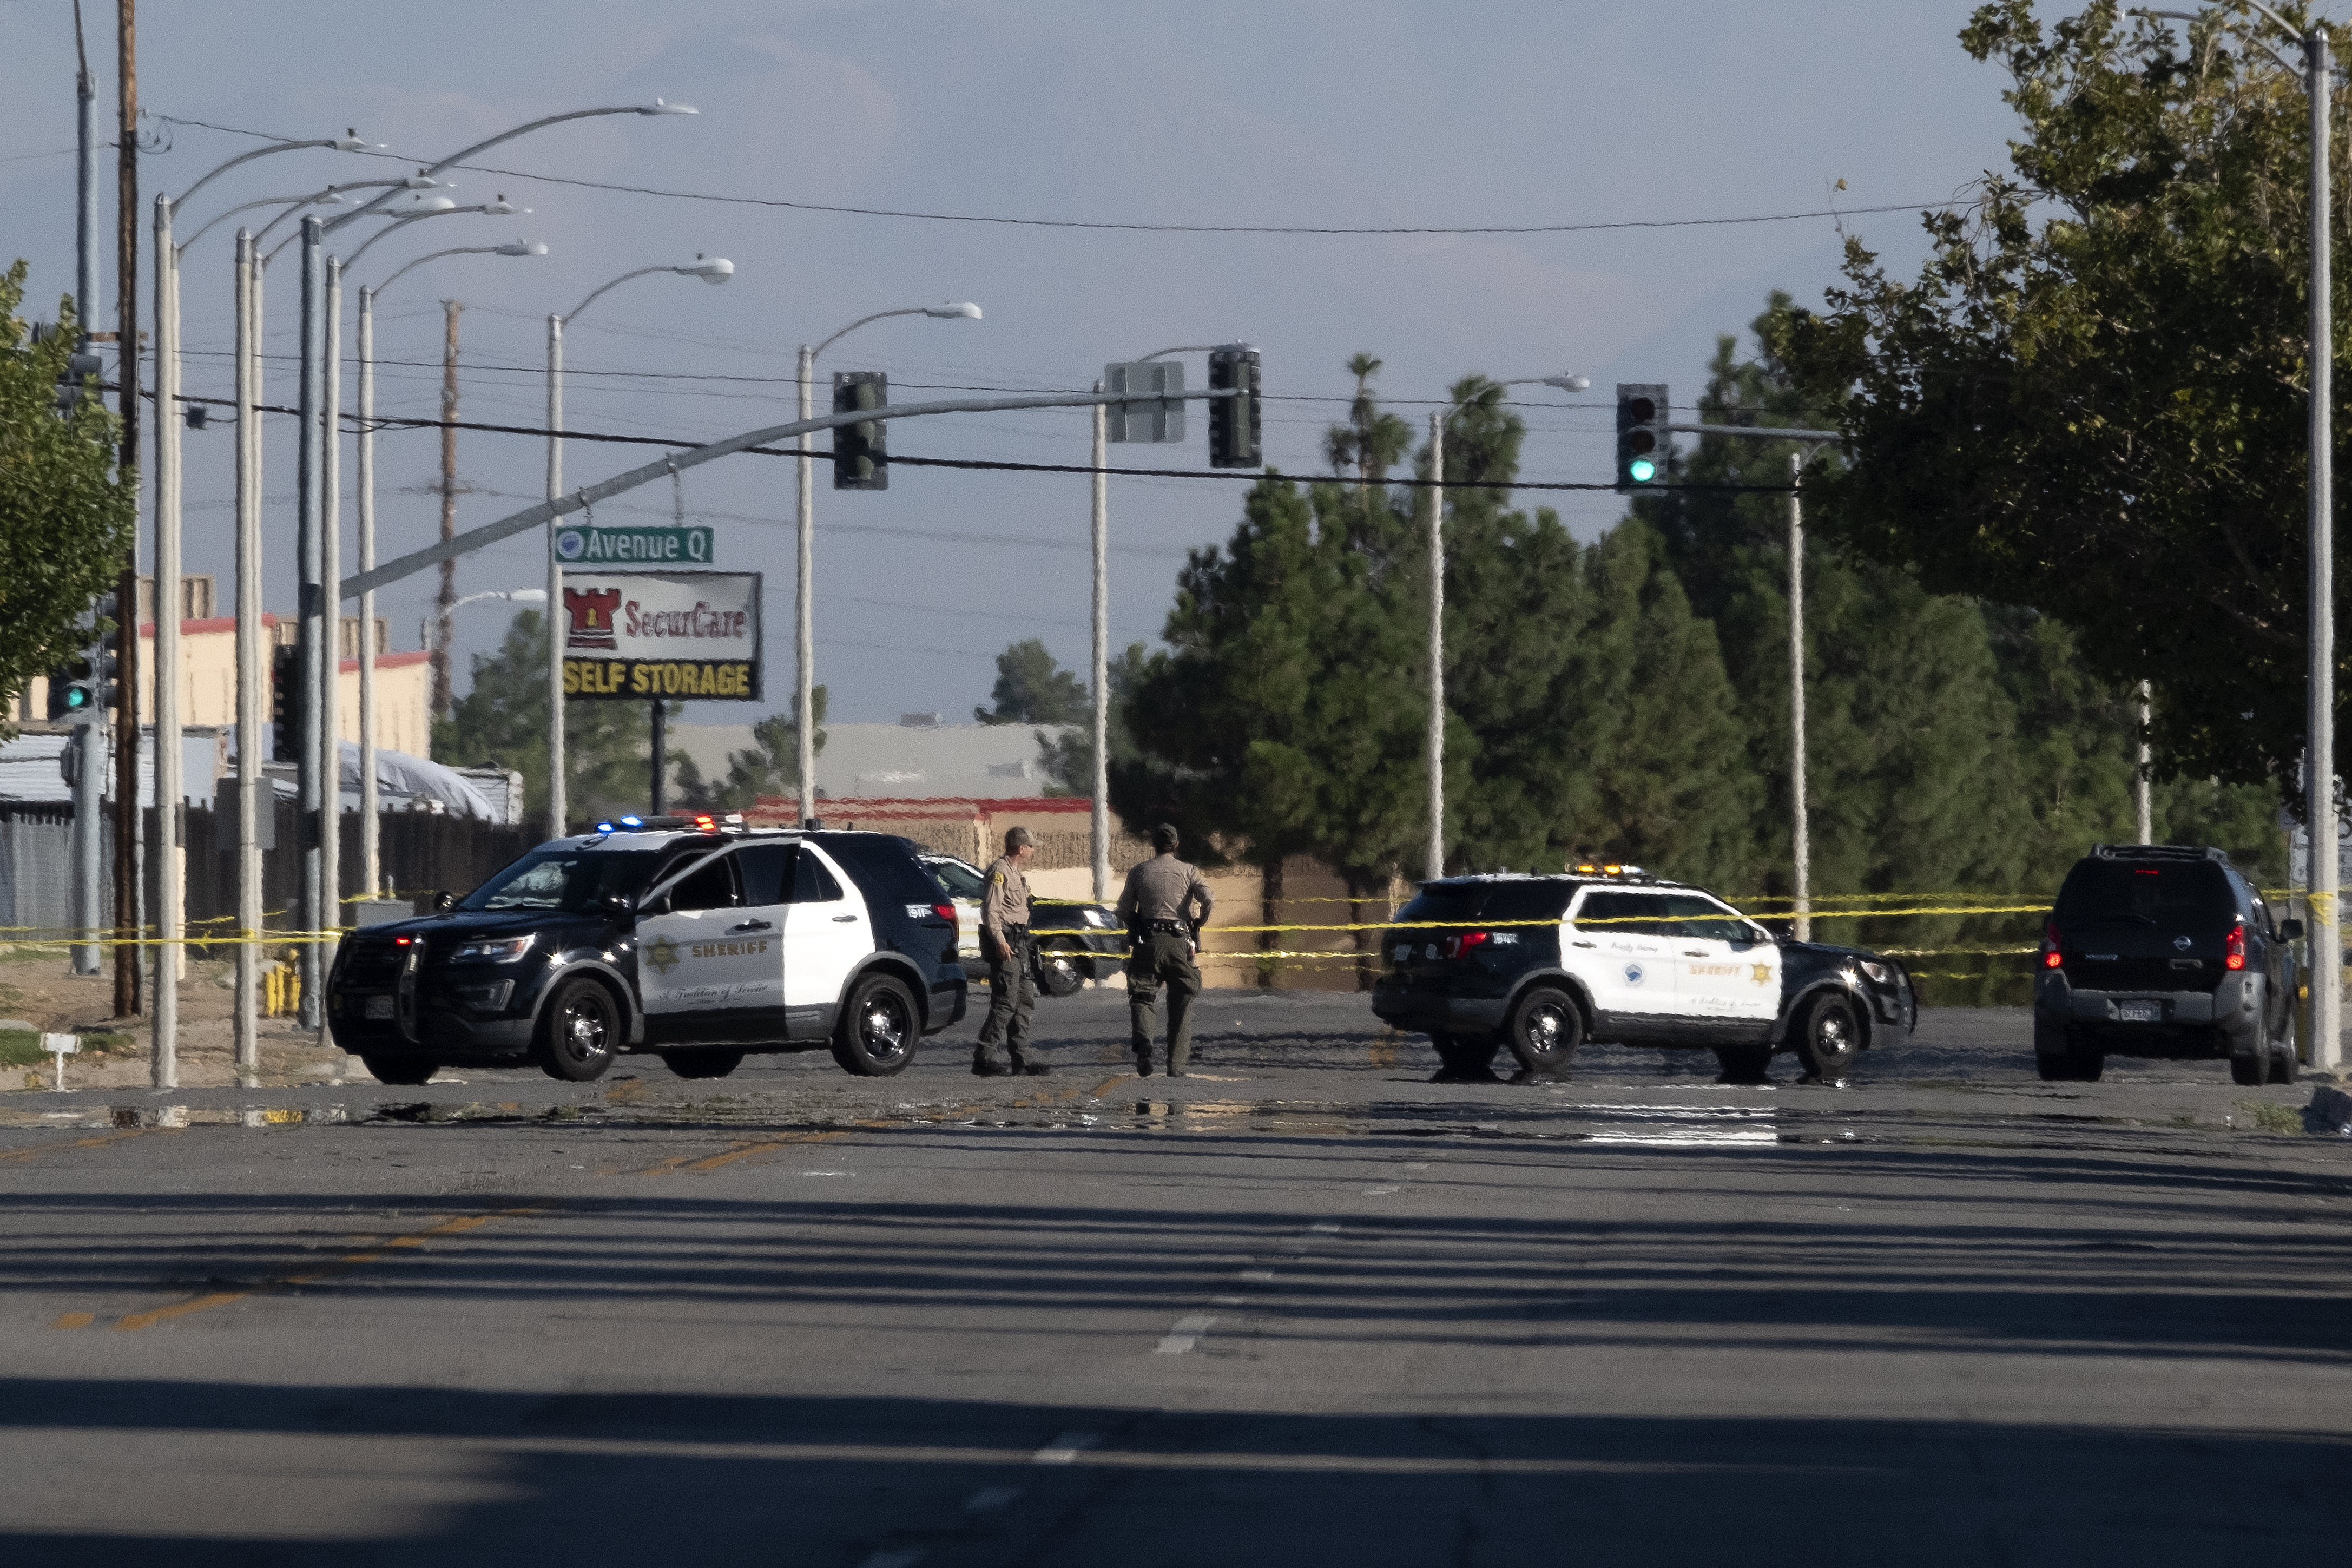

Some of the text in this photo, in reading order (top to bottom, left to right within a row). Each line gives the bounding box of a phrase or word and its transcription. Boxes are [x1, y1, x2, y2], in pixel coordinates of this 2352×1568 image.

[587, 529, 704, 562] Avenue Q
[625, 601, 746, 638] SecurCare
[563, 661, 750, 695] SELF STORAGE
[692, 940, 767, 958] SHERIFF
